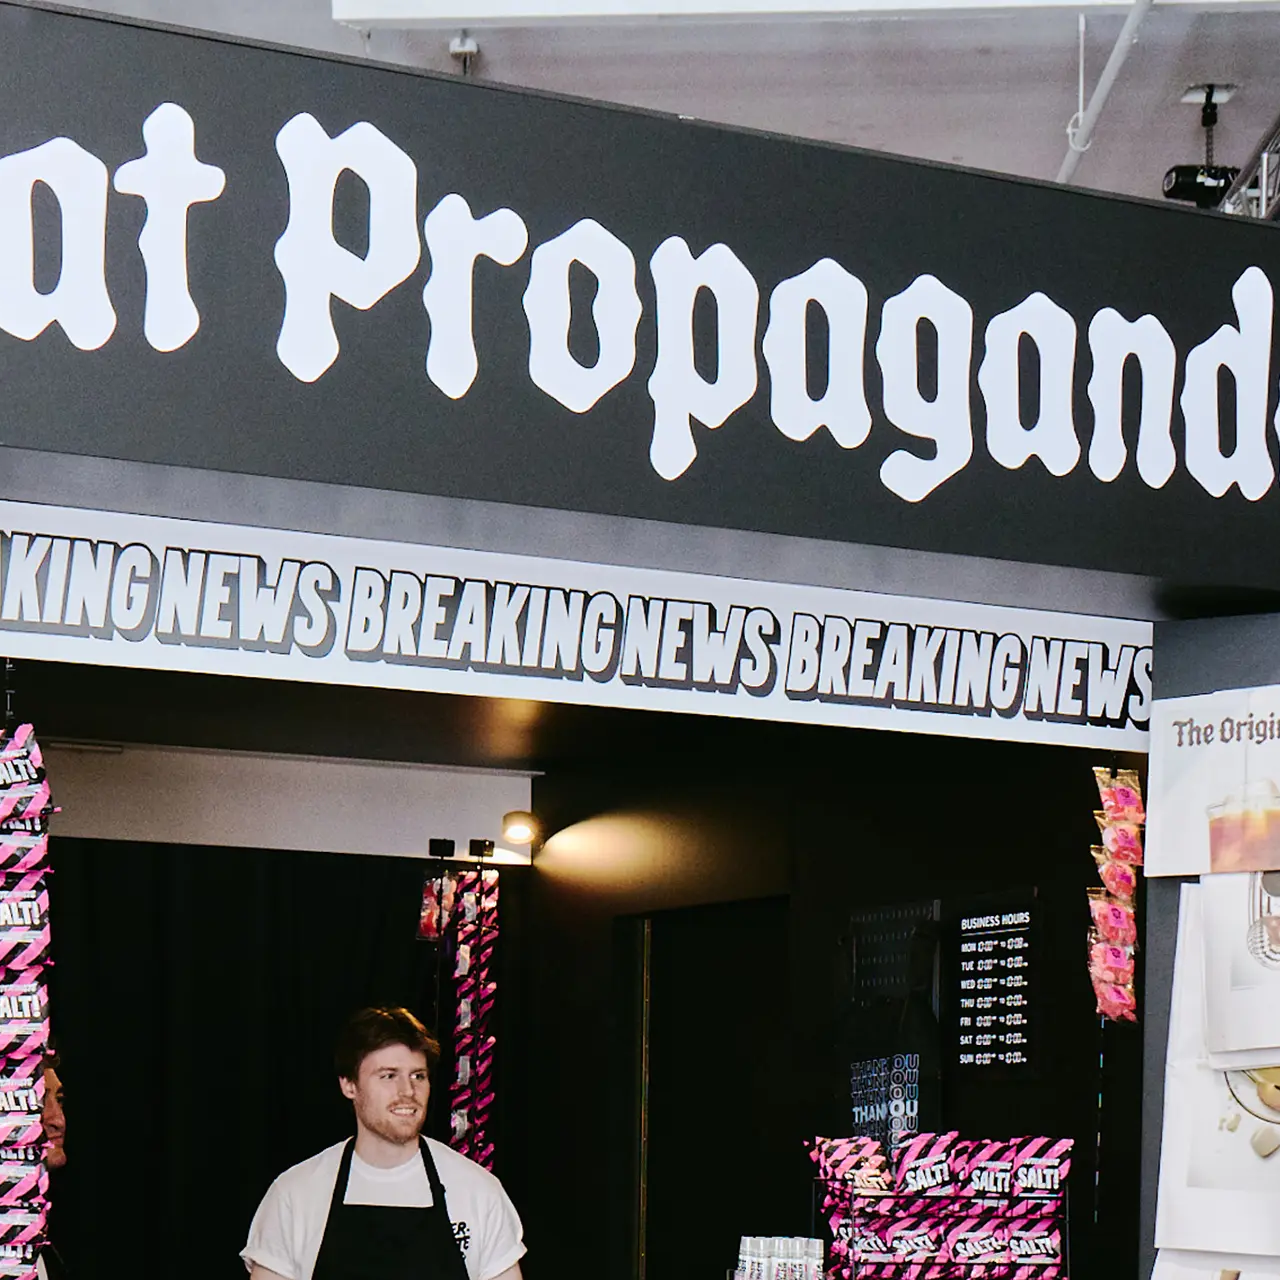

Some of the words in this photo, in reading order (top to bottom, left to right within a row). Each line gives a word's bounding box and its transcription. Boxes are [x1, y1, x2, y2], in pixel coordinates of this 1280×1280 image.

[154, 545, 341, 658] NEWS
[345, 567, 623, 683] BREAKING
[620, 595, 780, 697] NEWS
[785, 612, 1022, 720] BREAKING
[1022, 636, 1153, 731] NEWS
[1173, 718, 1215, 748] The
[961, 914, 1000, 930] BUSINESS
[1001, 912, 1030, 925] HOURS
[905, 1163, 950, 1192] SALT!
[971, 1169, 1012, 1193] SALT!
[1017, 1167, 1060, 1190] SALT!
[892, 1234, 936, 1254] SALT!
[955, 1236, 1001, 1257] SALT!
[1009, 1237, 1054, 1255] SALT!
